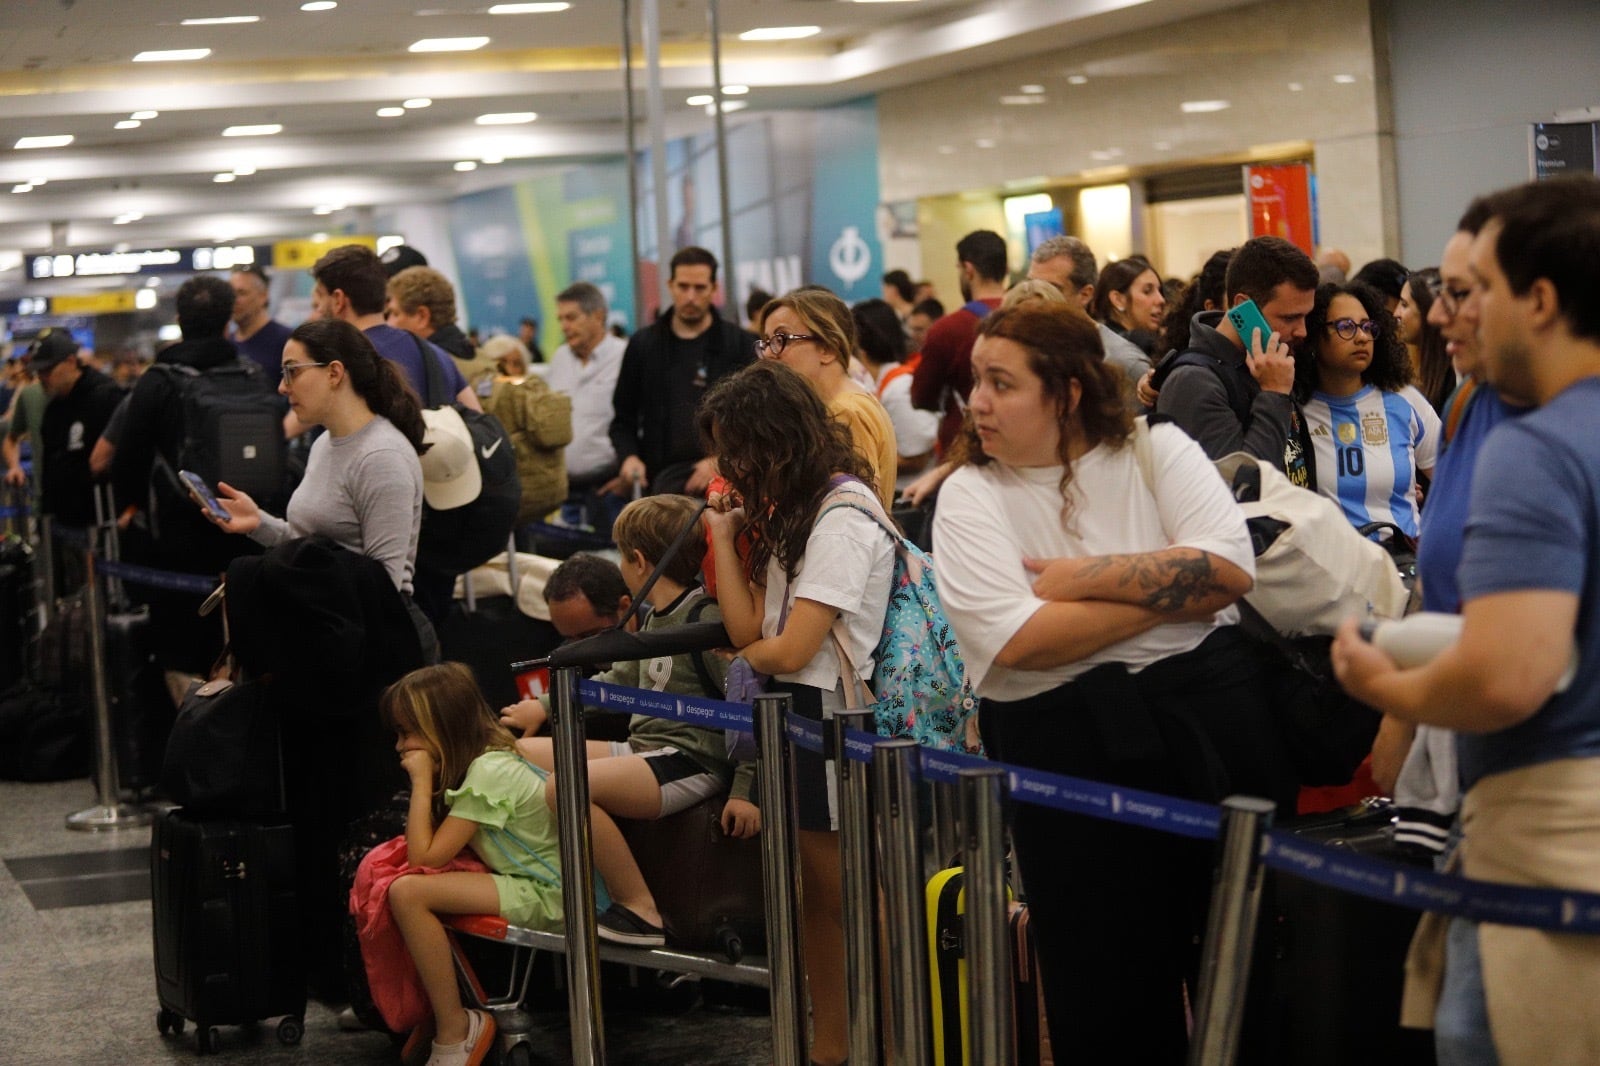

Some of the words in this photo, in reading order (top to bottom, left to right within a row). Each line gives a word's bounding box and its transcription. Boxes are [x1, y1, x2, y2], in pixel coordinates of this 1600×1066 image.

[1337, 446, 1364, 477] 10
[648, 655, 673, 692] 9
[609, 692, 636, 706] despegar
[686, 704, 715, 719] despegar
